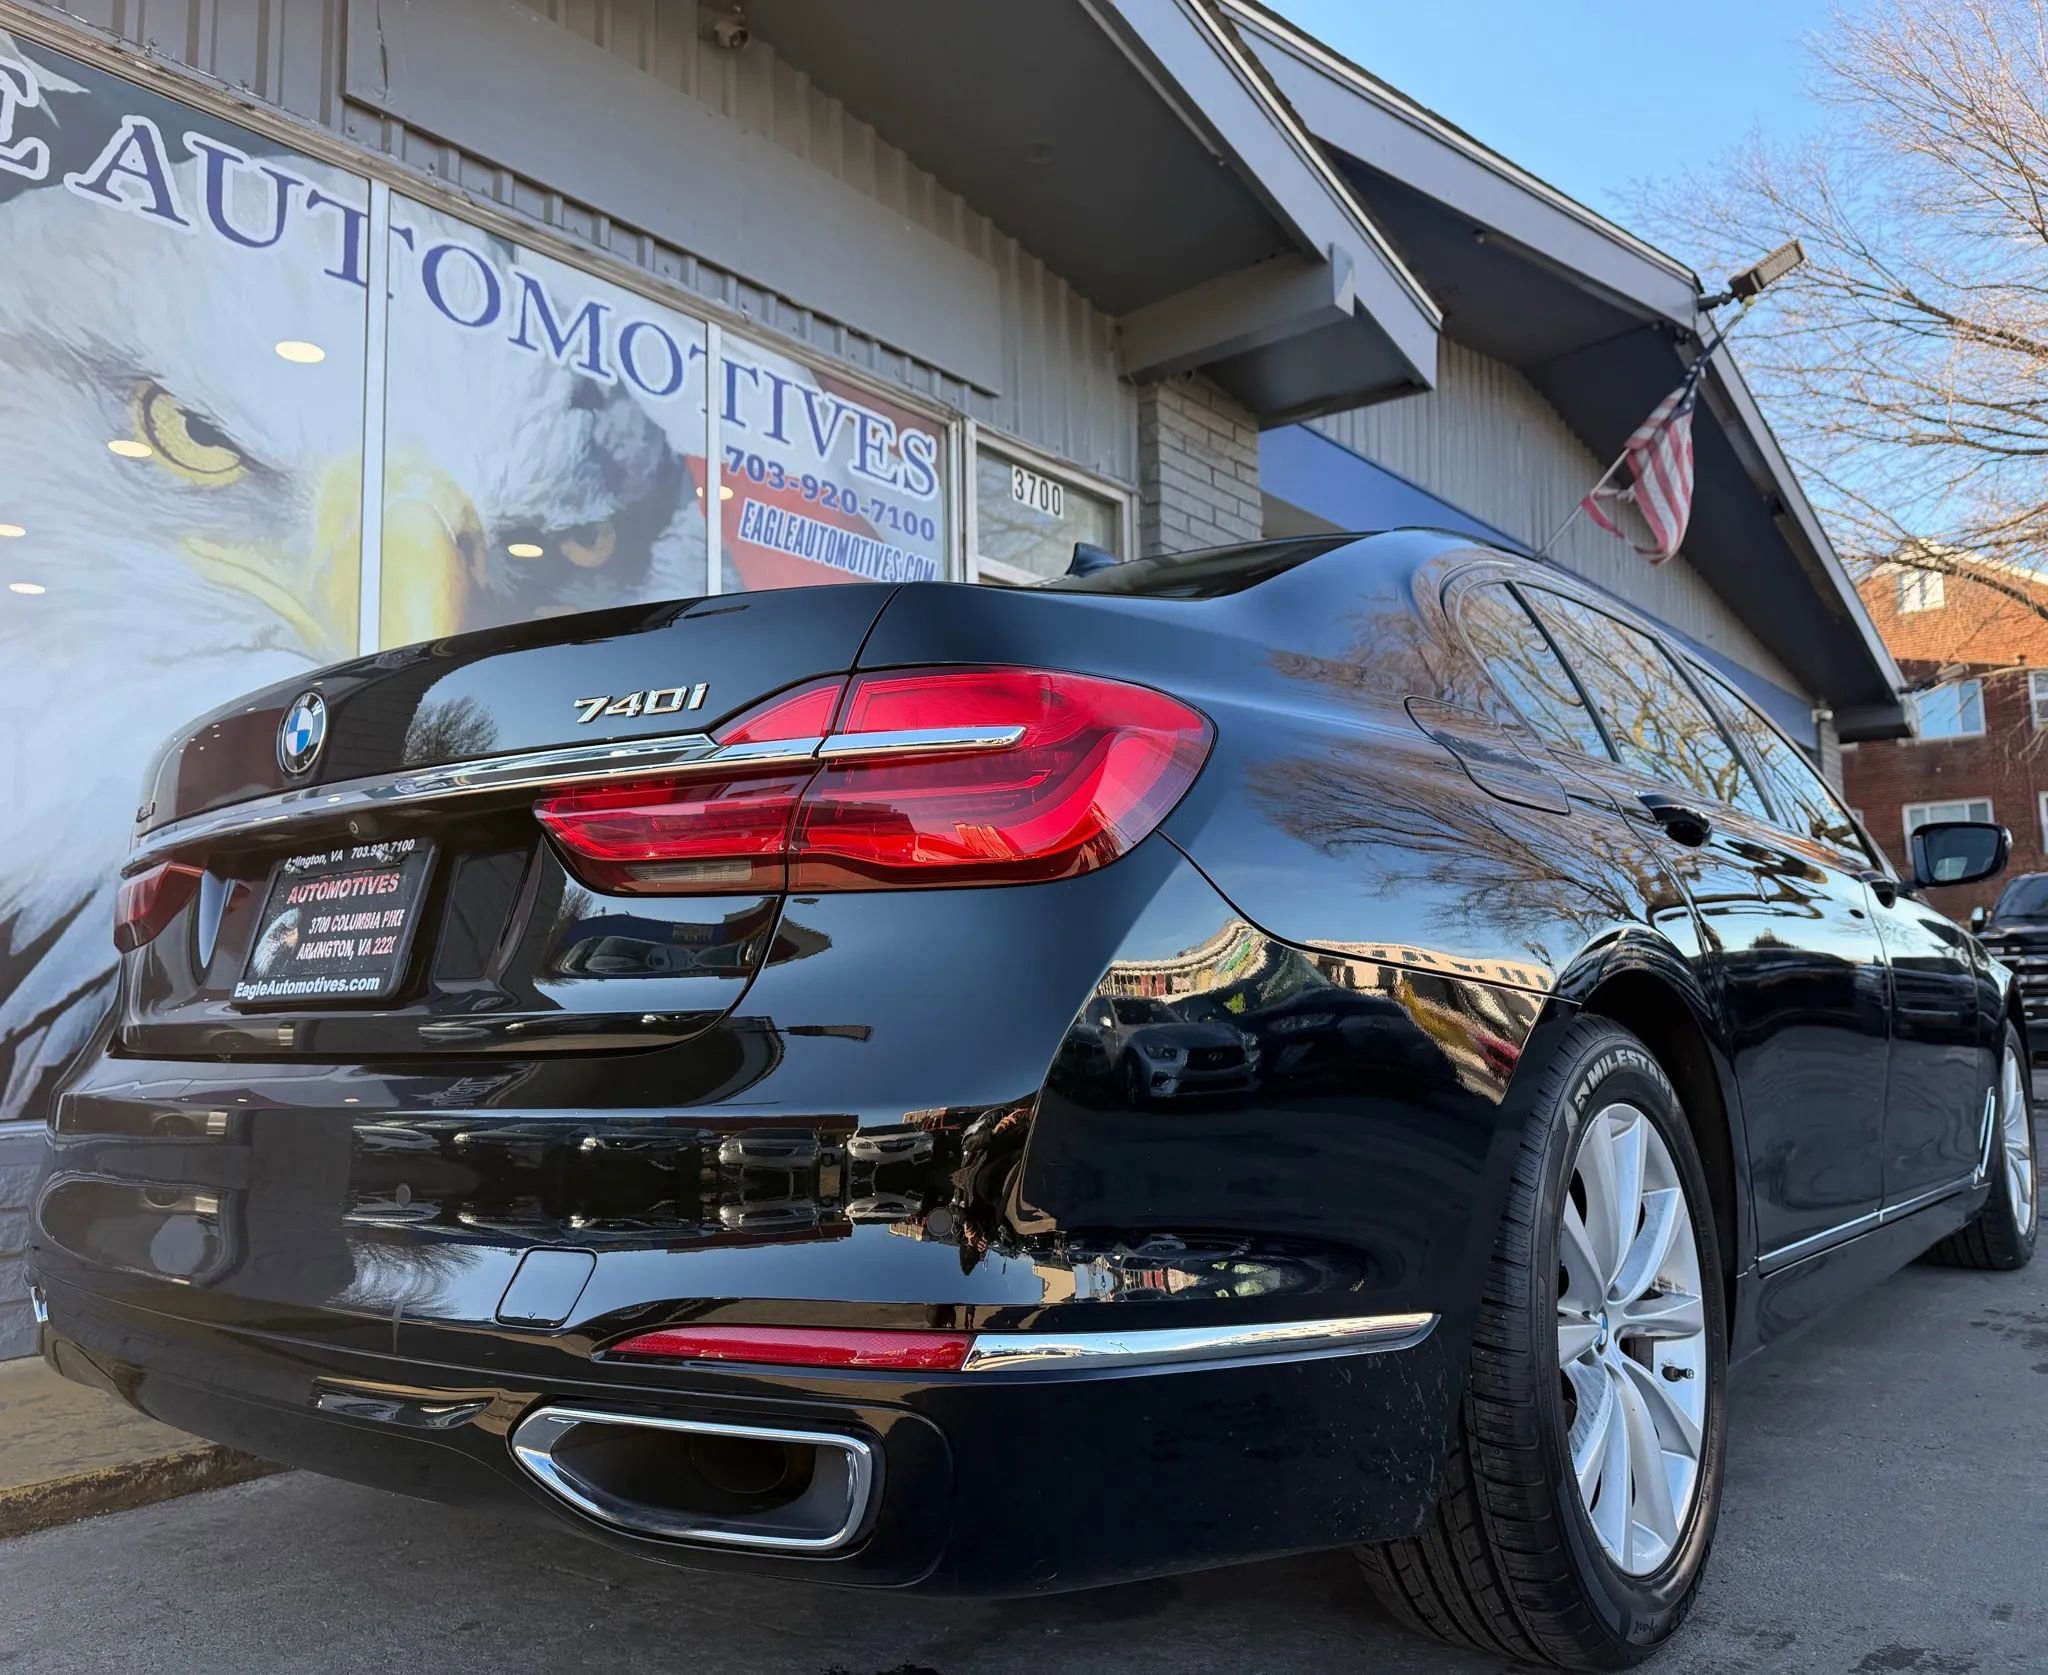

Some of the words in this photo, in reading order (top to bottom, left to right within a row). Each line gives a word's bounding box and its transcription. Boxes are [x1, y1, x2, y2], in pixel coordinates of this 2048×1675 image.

[68, 120, 938, 500] AUTOMOTIVES
[725, 444, 936, 543] 703-920-7100
[1013, 467, 1062, 517] 3700
[740, 500, 938, 583] EAGLEAUTOMOTIVES.COM
[573, 681, 710, 724] 740i
[330, 849, 344, 863] VA
[286, 872, 401, 906] AUTOMOTIVES
[308, 915, 332, 935] 3700
[330, 910, 381, 932] COLUMBIA
[381, 908, 406, 929] PIKE
[295, 939, 355, 961] ARLINGTON,
[357, 937, 372, 956] VA
[233, 975, 381, 1000] EagleAutomotives.com
[1586, 1049, 1673, 1096] MILESTAR
